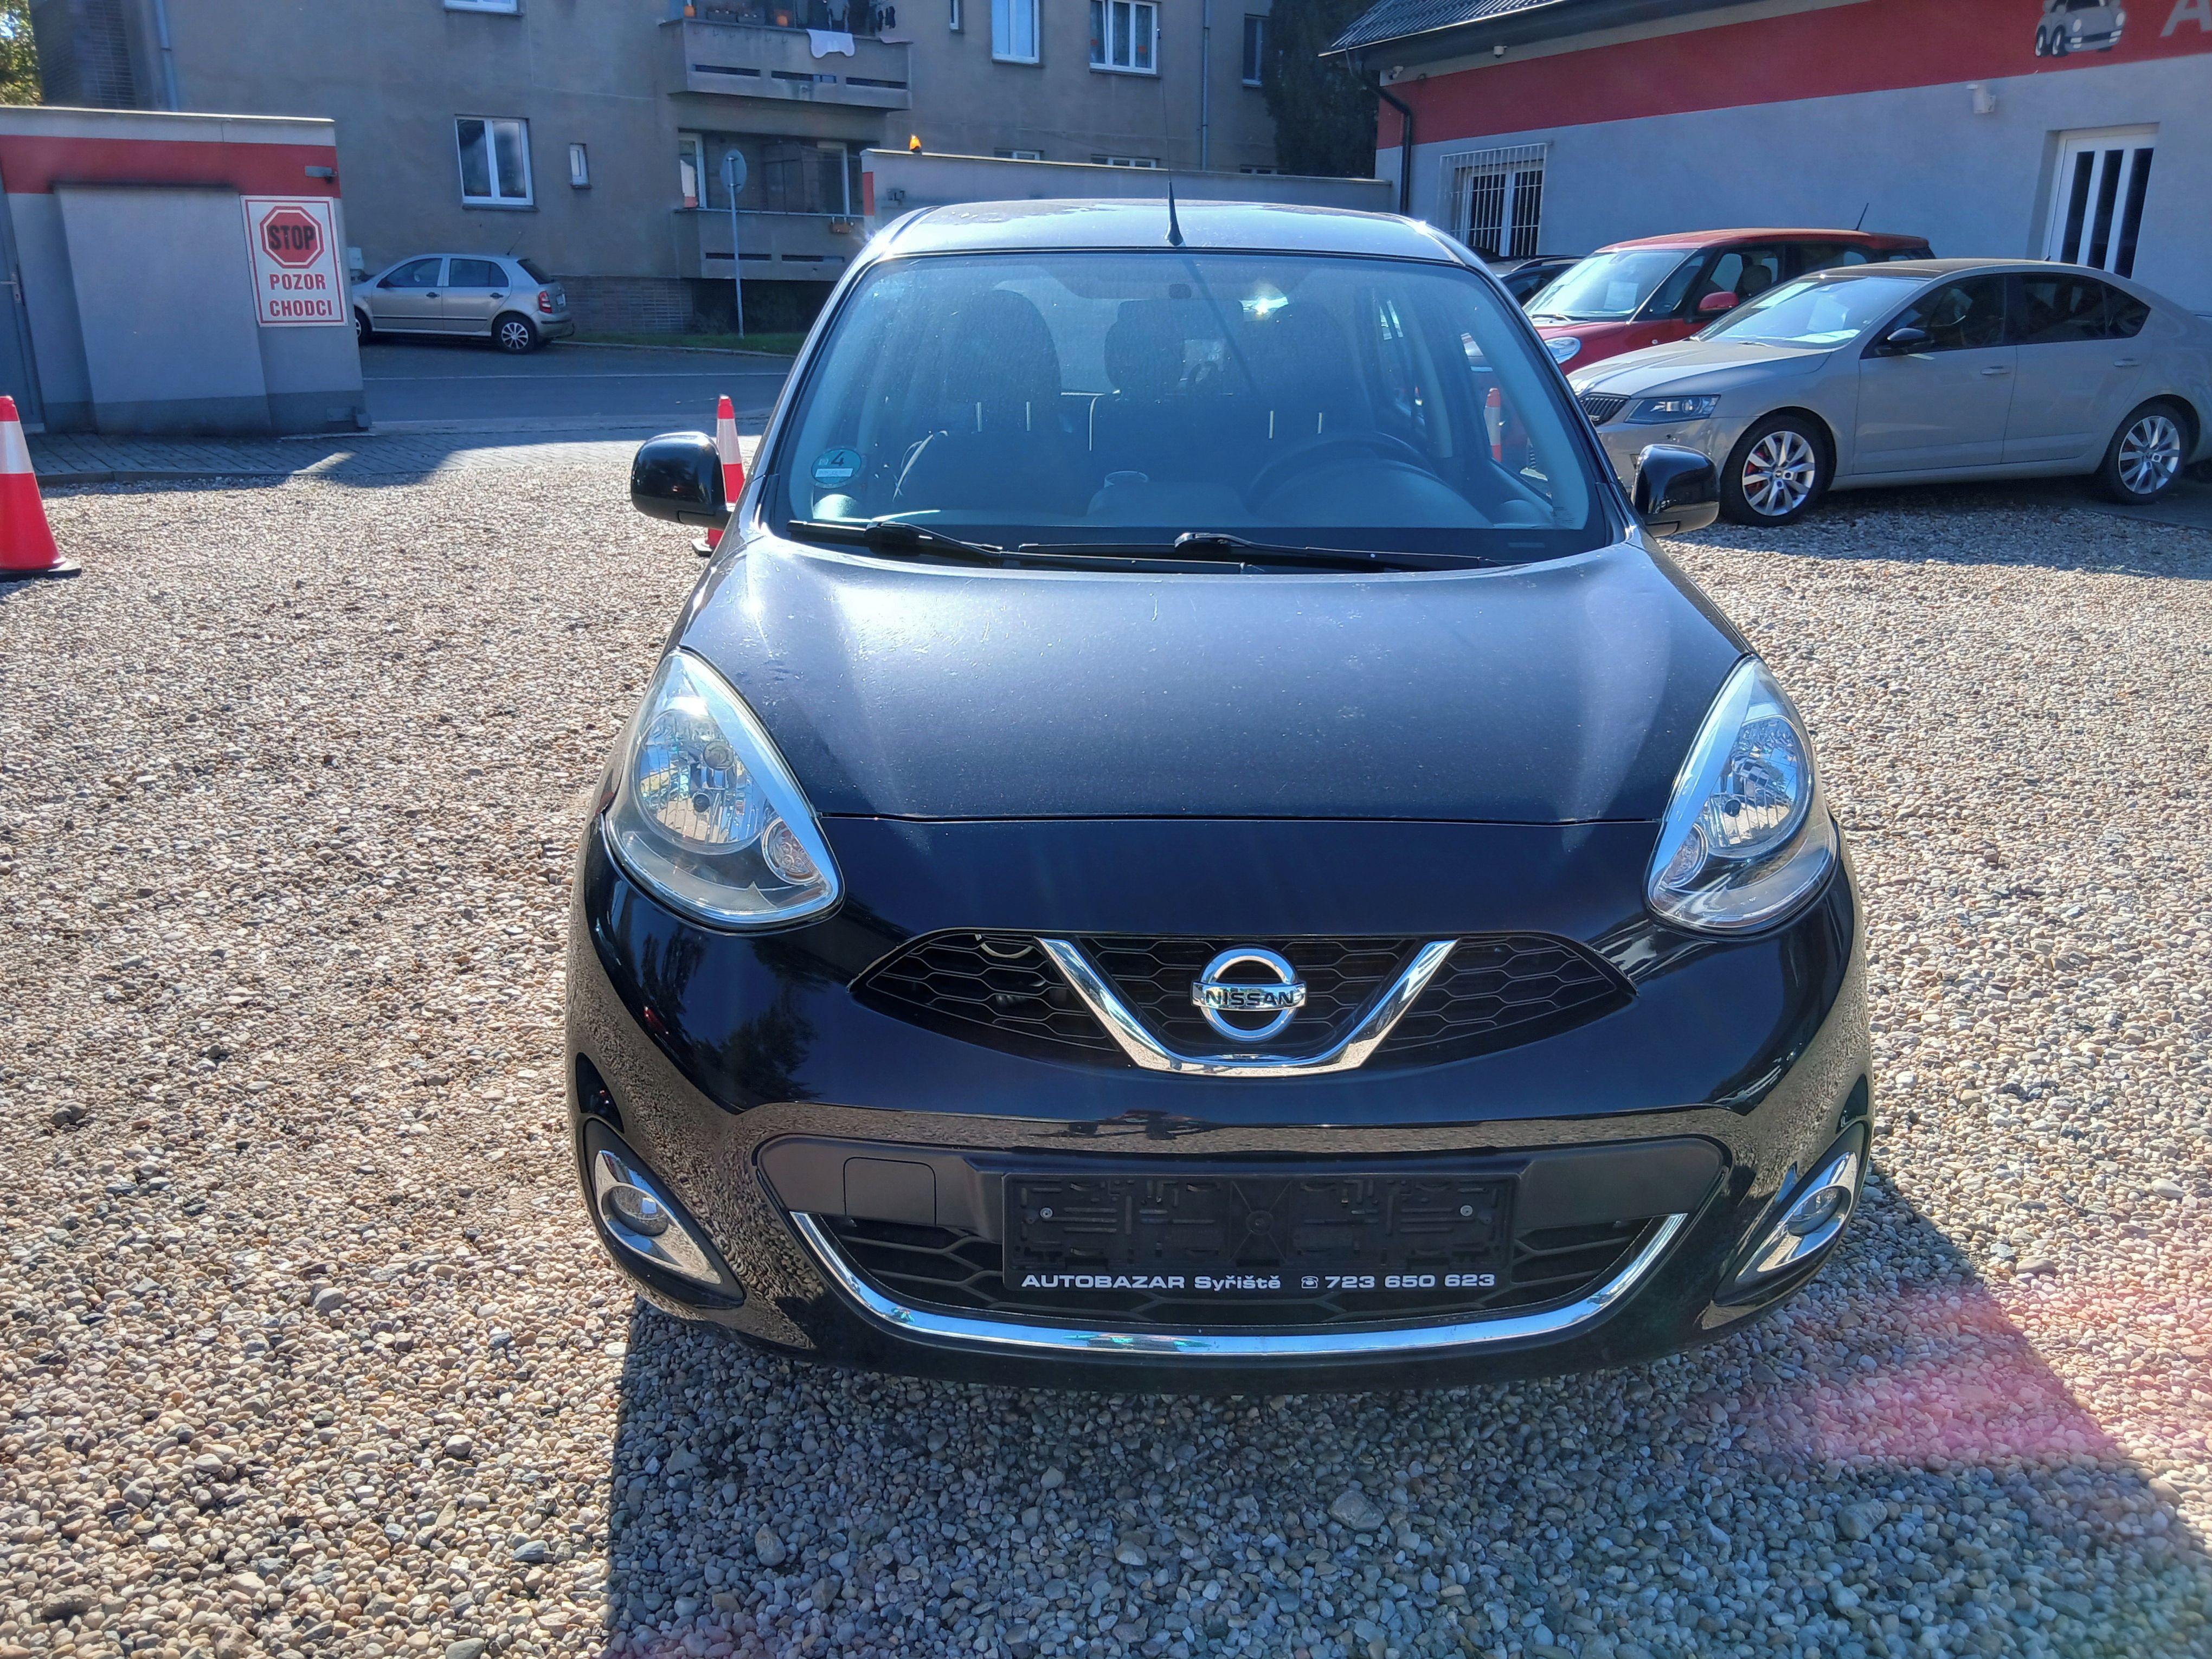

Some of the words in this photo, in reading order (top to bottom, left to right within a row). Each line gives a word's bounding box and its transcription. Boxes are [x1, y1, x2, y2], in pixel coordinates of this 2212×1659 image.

[268, 224, 315, 250] STOP
[269, 274, 326, 290] POZOR
[269, 300, 332, 317] CHODCI
[831, 451, 844, 466] 4
[1205, 990, 1294, 1006] NISSAN
[1021, 1275, 1185, 1289] AUTOBAZAR
[1194, 1275, 1281, 1291] Syřiště
[1324, 1276, 1375, 1288] 723
[1385, 1275, 1435, 1288] 650
[1444, 1274, 1495, 1287] 623
